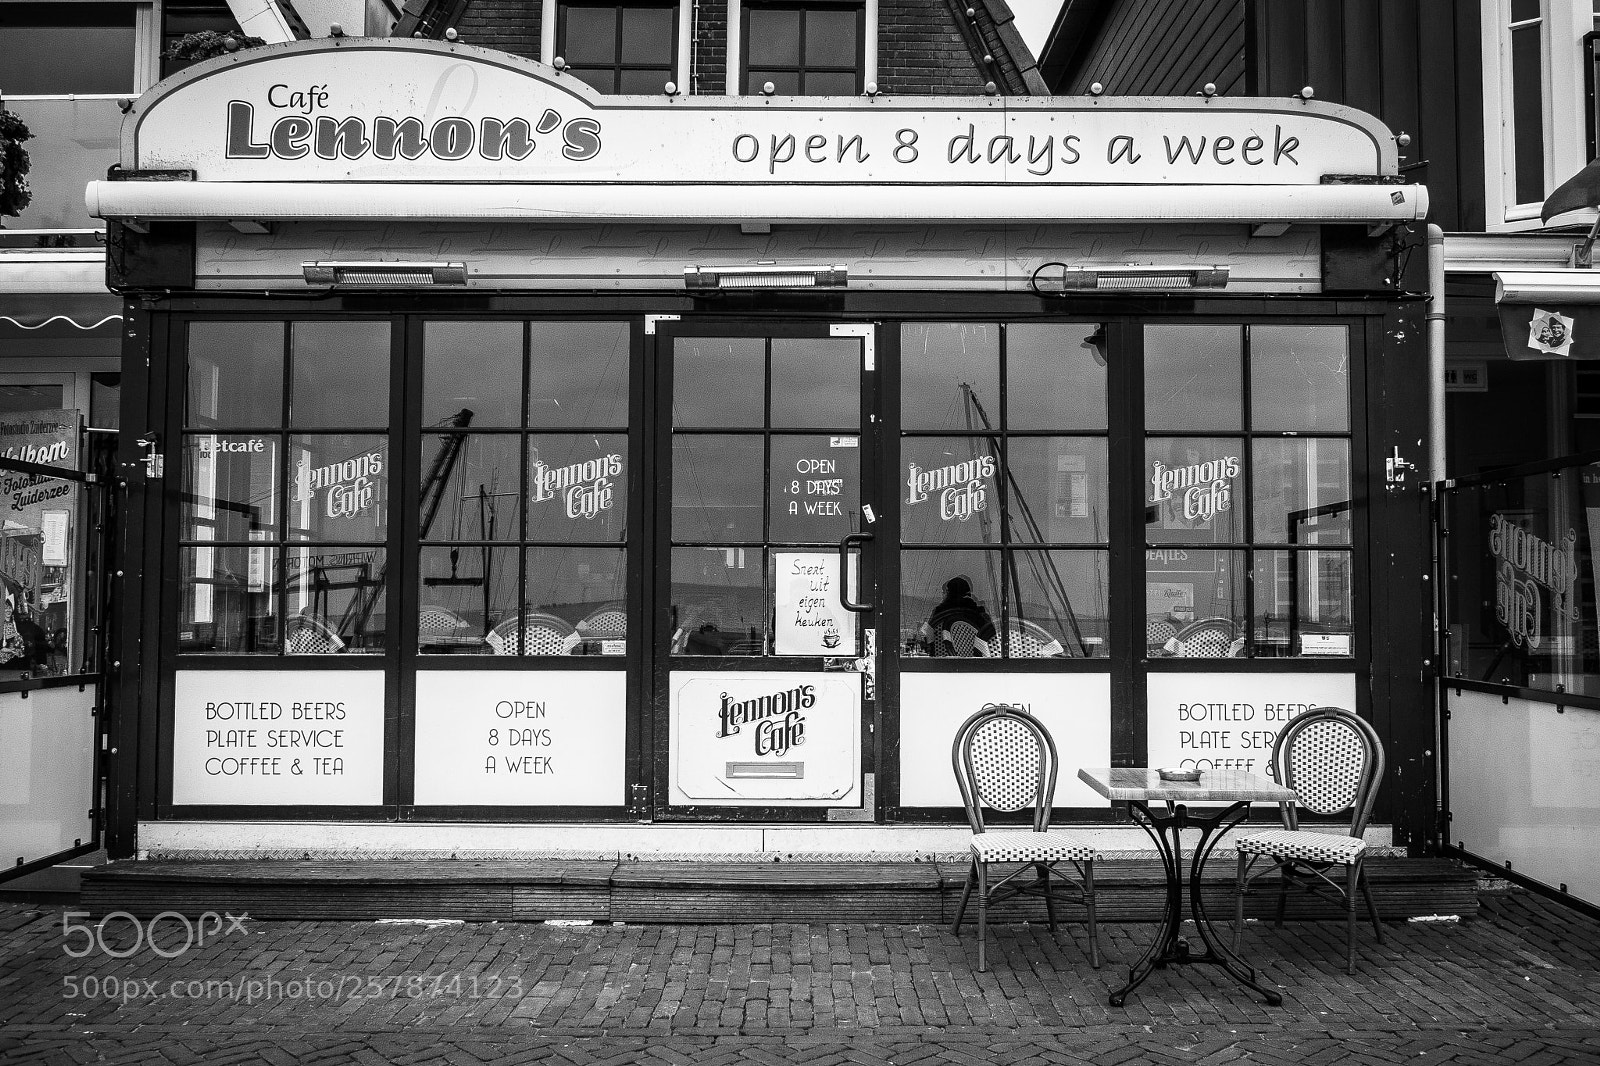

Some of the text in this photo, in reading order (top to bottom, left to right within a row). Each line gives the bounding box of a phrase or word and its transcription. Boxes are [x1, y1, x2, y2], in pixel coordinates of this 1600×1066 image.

[267, 84, 329, 114] Café
[225, 100, 601, 161] Lennon's
[732, 124, 1300, 175] open 8 days a week
[796, 459, 835, 473] OPEN
[532, 454, 624, 502] Lennon's
[791, 480, 840, 494] 8 DAYS
[906, 455, 995, 505] Lennon's
[1149, 456, 1240, 502] Lennon's
[12, 484, 71, 511] Zuiderzee
[327, 477, 374, 518] Café
[567, 478, 613, 519] Café
[940, 480, 987, 522] Café
[1184, 479, 1231, 521] Café
[789, 501, 842, 515] A WEEK
[1146, 549, 1187, 564] EATLES
[810, 575, 829, 591] uit
[799, 595, 825, 613] eigen
[794, 610, 834, 627] keuken
[205, 701, 346, 721] BOTTLED BEERS
[495, 700, 546, 719] OPEN
[716, 685, 816, 738] Lennon's
[1178, 703, 1255, 721] BOTTLED
[205, 729, 344, 748] PLATE SERVICE
[488, 728, 552, 747] 8 DAYS
[755, 711, 806, 757] Café
[1179, 731, 1231, 748] PLATE
[205, 757, 344, 776] COFFEE & TEA
[485, 755, 554, 775] A WEEK
